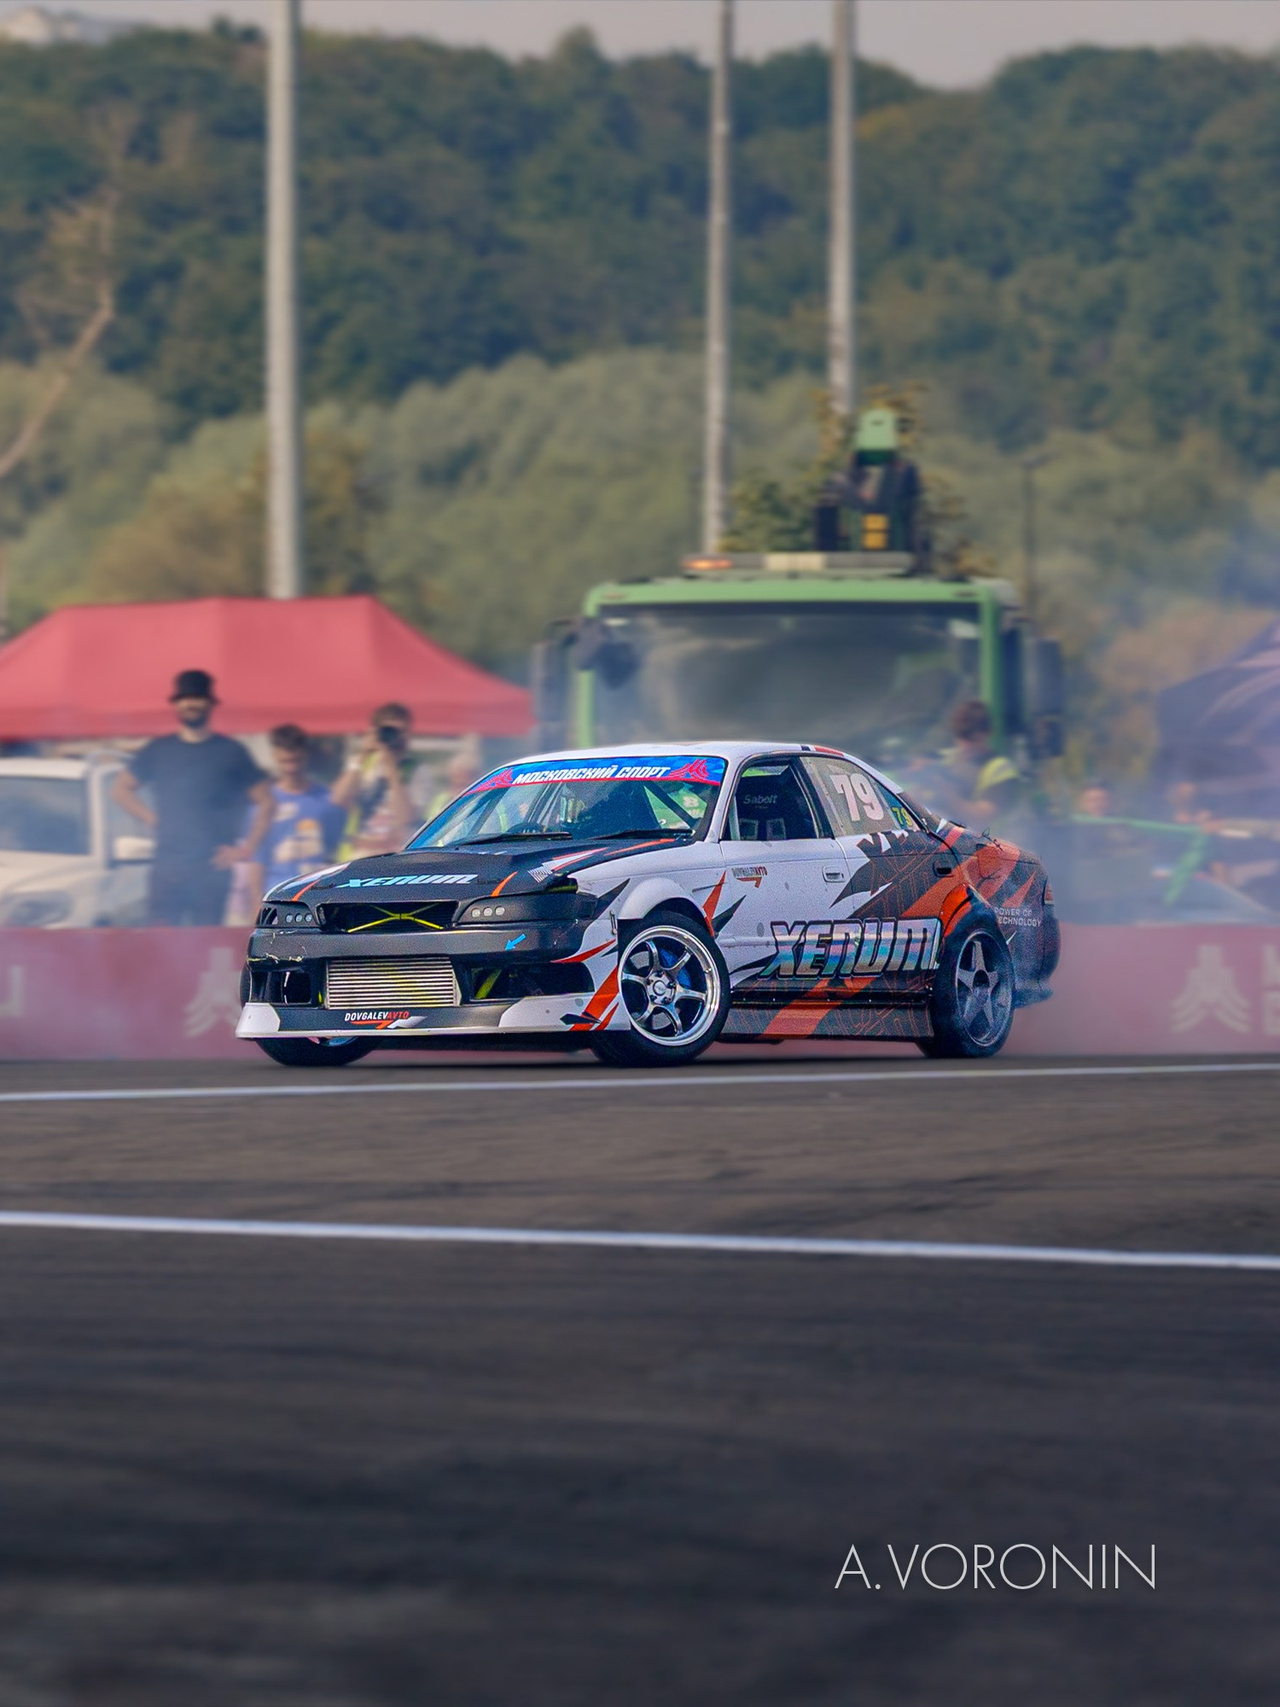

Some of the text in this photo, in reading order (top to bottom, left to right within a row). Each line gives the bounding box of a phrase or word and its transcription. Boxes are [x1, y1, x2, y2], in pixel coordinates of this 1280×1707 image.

[512, 765, 671, 785] МОСКОВСКИЙ СПОРТ
[829, 773, 884, 822] 79
[891, 807, 913, 827] 79
[994, 907, 1020, 916] POWER
[998, 916, 1041, 927] ECHNOLOGY
[758, 918, 941, 979] XENUM
[344, 1011, 410, 1022] DOVGALEVAVTO
